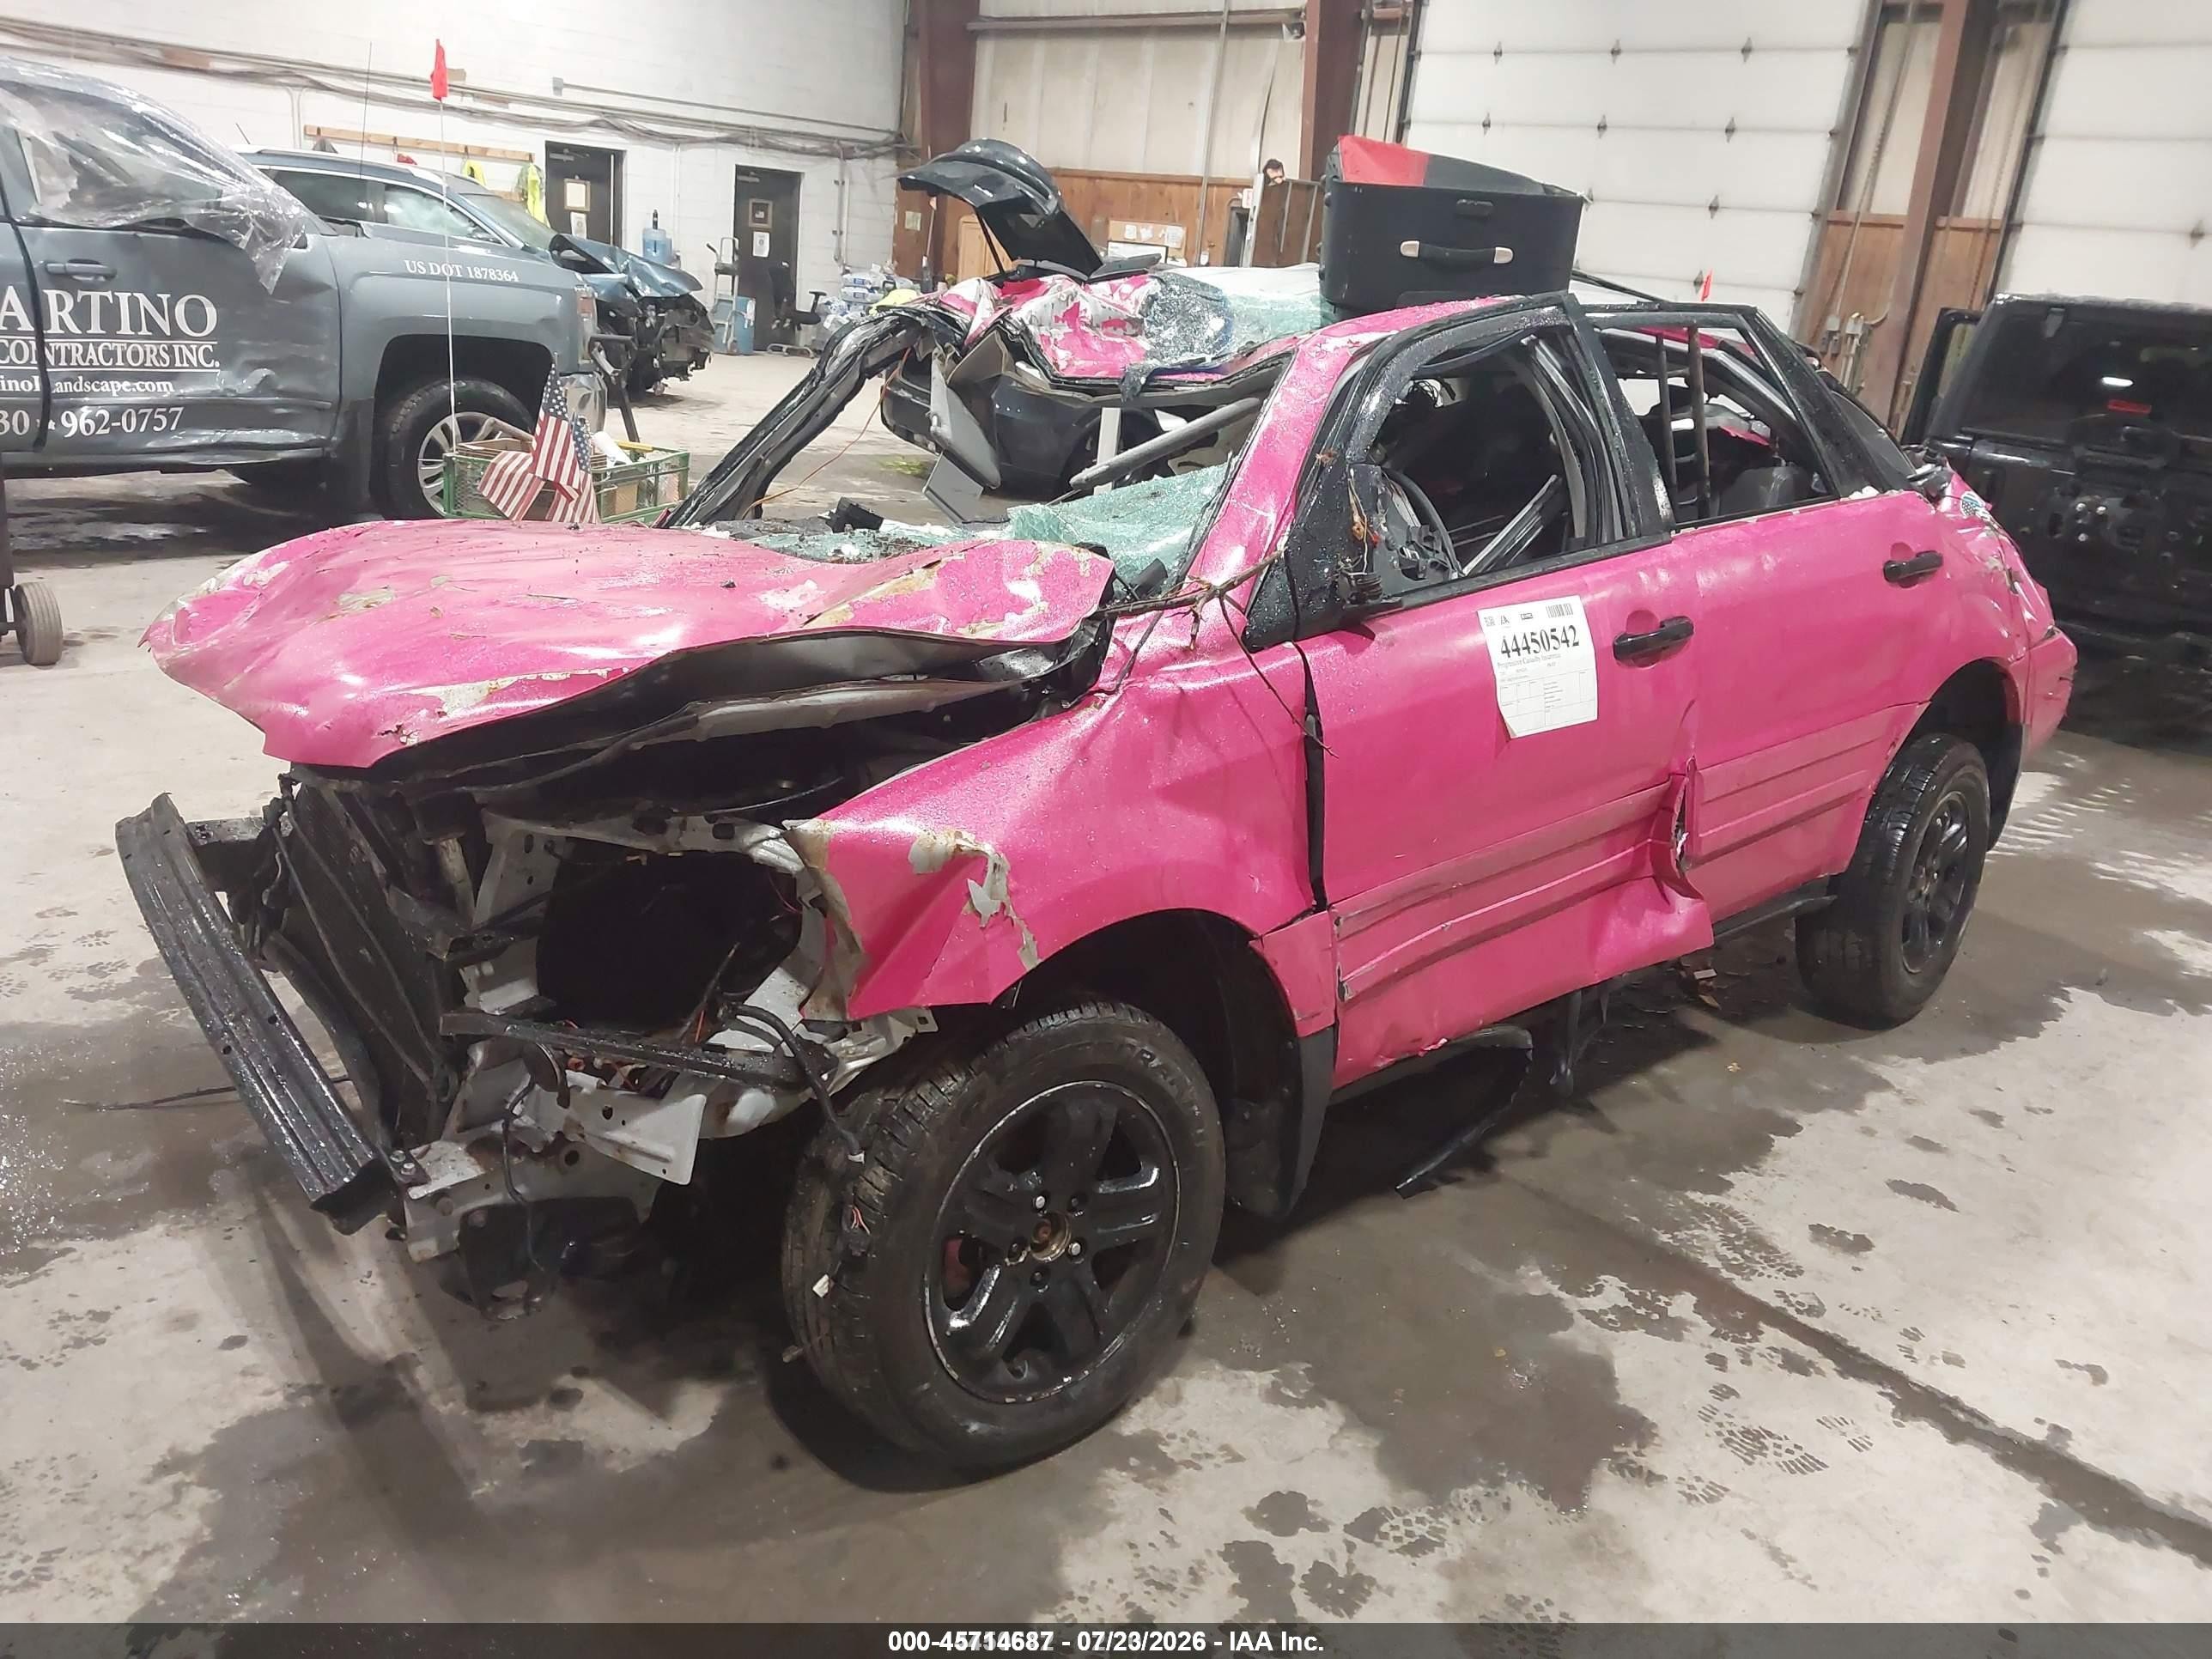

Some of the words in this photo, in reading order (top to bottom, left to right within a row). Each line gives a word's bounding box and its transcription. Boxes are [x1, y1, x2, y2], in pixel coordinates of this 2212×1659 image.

[404, 260, 427, 274] US
[428, 262, 463, 277] DOT
[466, 266, 520, 282] 1878364
[0, 285, 218, 337] ARTINO
[173, 343, 220, 368] INC.
[61, 405, 185, 438] 962-0757
[1500, 625, 1580, 658] 44450542
